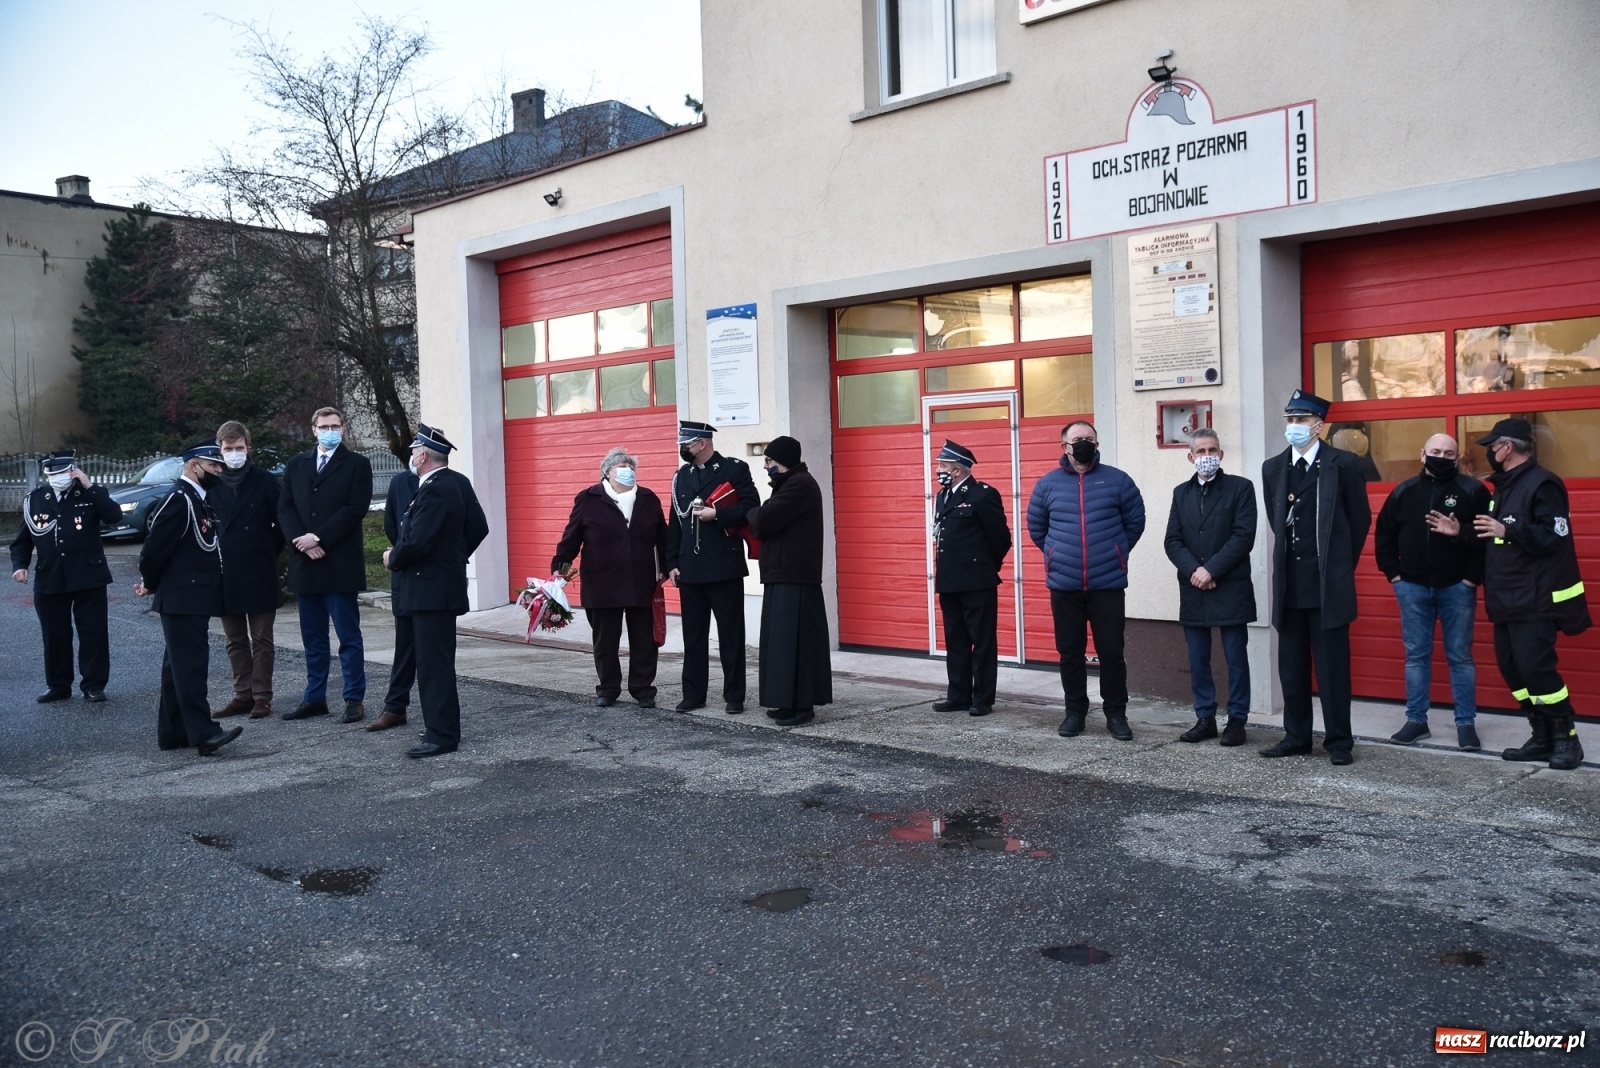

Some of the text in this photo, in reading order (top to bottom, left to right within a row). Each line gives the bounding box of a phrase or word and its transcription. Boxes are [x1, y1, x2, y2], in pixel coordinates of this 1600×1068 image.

[1296, 110, 1308, 200] 1960
[1163, 167, 1178, 189] W
[1052, 160, 1062, 240] 1920
[1128, 185, 1209, 217] BOJANOWIE
[1134, 236, 1211, 253] TABLICA INFORMACYJNA
[1153, 232, 1190, 243] ALARMOWA
